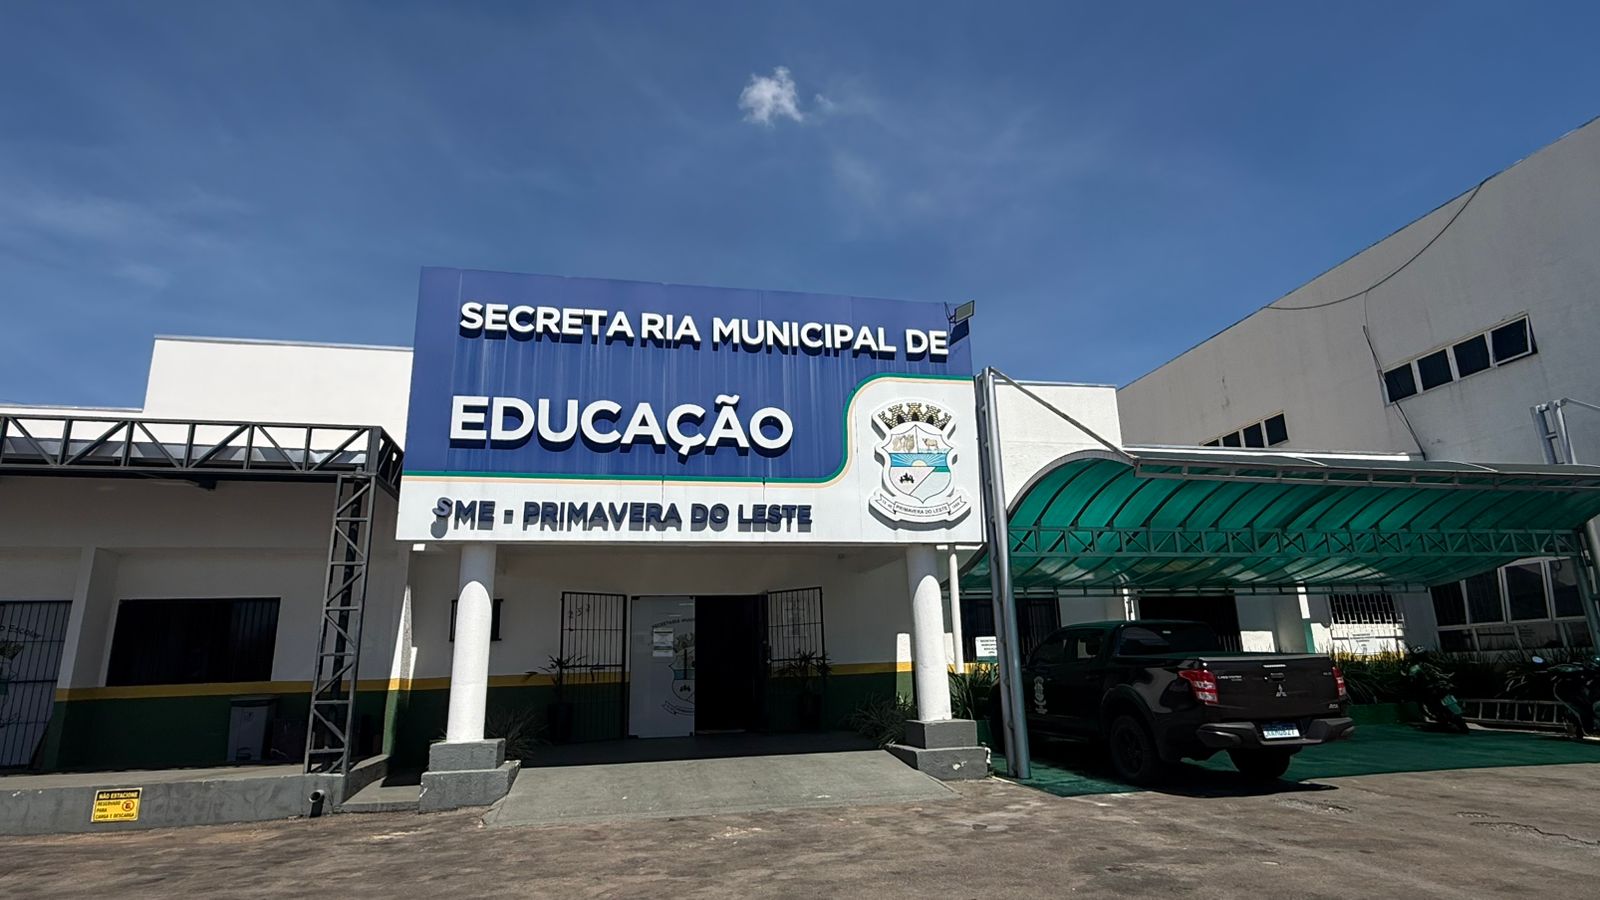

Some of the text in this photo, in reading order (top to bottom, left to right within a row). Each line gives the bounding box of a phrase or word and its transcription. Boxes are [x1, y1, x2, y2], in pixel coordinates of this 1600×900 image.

[459, 301, 949, 359] SECRETARIA MUNICIPAL DE
[450, 394, 794, 459] EDUCAÇÃO
[432, 497, 496, 530] SME
[523, 501, 683, 530] PRIMAVERA
[690, 502, 730, 531] DO
[737, 504, 812, 532] LESTE
